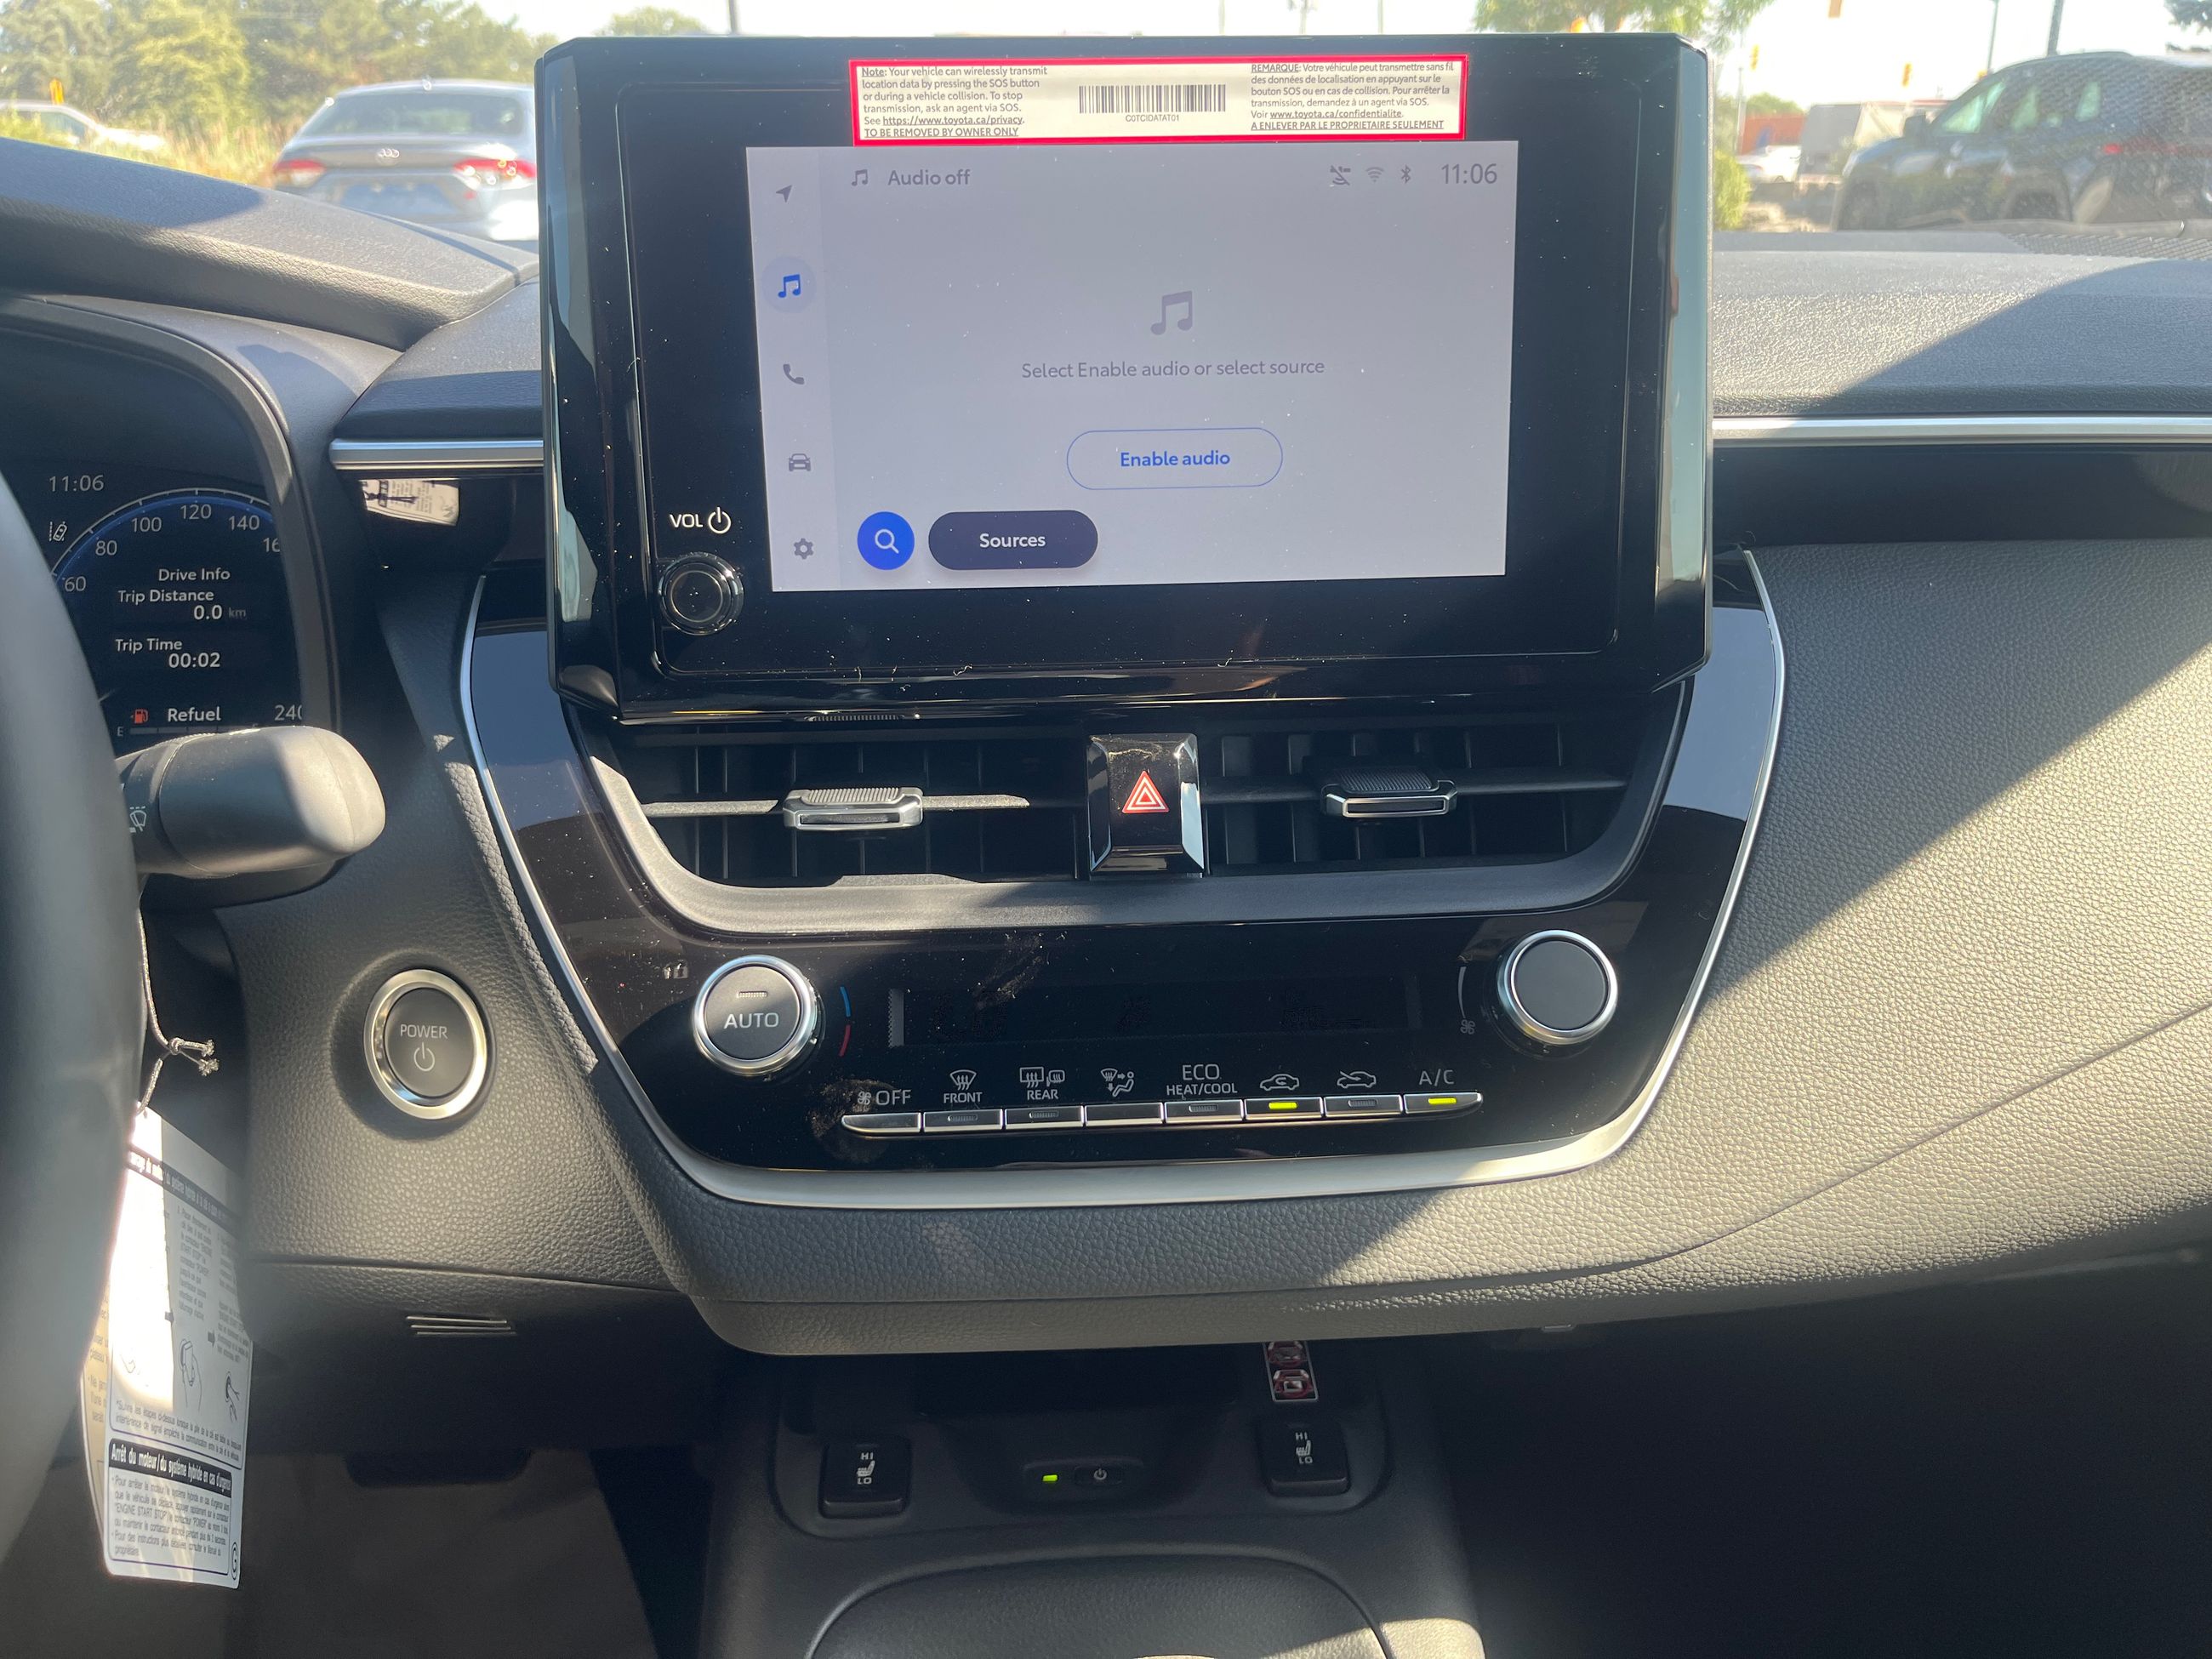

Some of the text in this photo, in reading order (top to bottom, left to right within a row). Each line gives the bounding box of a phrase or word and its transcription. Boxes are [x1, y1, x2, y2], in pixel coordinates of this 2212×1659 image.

[862, 68, 887, 77] Note:
[889, 67, 909, 76] Your
[912, 67, 944, 76] vehicle
[964, 66, 1007, 77] wirelessly
[1009, 66, 1047, 75] transmit
[1251, 65, 1301, 73] REMARQUE:
[1325, 63, 1357, 72] véhicule
[1360, 64, 1377, 73] peut
[1379, 63, 1425, 71] transmettre
[863, 79, 1039, 89] location data by pressing the SOS button
[1251, 76, 1266, 84] des
[1268, 75, 1303, 83] données
[1306, 75, 1315, 83] de
[1318, 75, 1364, 83] localisation
[1378, 76, 1417, 85] appuyant
[1433, 74, 1440, 83] le
[875, 92, 904, 102] during
[915, 92, 945, 100] vehicle
[948, 91, 988, 100] collision.
[990, 91, 1001, 100] To
[1003, 91, 1023, 102] stop
[1251, 87, 1281, 96] bouton
[1284, 87, 1301, 95] SOS
[1342, 86, 1352, 94] de
[1354, 86, 1390, 94] collision.
[1393, 86, 1411, 94] Pour
[1412, 85, 1440, 94] arrêter
[1442, 85, 1450, 94] la
[864, 105, 923, 114] transmission,
[926, 104, 940, 112] ask
[956, 105, 983, 114] agent
[984, 104, 997, 112] via
[1000, 104, 1021, 112] SOS.
[1251, 99, 1304, 108] transmission,
[1307, 98, 1349, 106] demandez
[1351, 97, 1356, 106] à
[1371, 98, 1394, 107] agent
[1397, 97, 1407, 105] via
[1410, 97, 1428, 105] SOS.
[864, 117, 881, 125] See
[1251, 111, 1268, 119] Voir
[1259, 121, 1297, 130] ENLEVER
[1300, 121, 1316, 129] PAR
[1319, 121, 1327, 129] LE
[1330, 121, 1390, 129] PROPRIETAIRE
[1393, 120, 1444, 129] SEULEMENT
[864, 128, 1018, 138] TO BE REMOVED BY OWNER ONLY
[887, 168, 971, 185] Audio off
[1441, 163, 1497, 185] 11:06
[1022, 360, 1325, 378] Select Enable audio or select source
[1120, 450, 1230, 466] Enable audio
[48, 474, 105, 493] 11:06
[180, 504, 212, 520] 120
[131, 516, 162, 533] 100
[229, 515, 260, 531] 140
[669, 514, 704, 527] VOL
[95, 539, 117, 556] 80
[263, 537, 281, 553] 16
[979, 533, 1046, 548] Sources
[158, 567, 231, 582] Drive Info
[64, 576, 87, 592] 60
[117, 589, 214, 605] Trip Distance
[193, 604, 247, 620] 0.0 km
[115, 638, 182, 653] Trip Time
[168, 652, 221, 668] 00:02
[168, 706, 221, 721] Refuel
[117, 727, 123, 738] E
[723, 1012, 780, 1029] AUTO
[400, 1023, 448, 1040] POWER
[1182, 1063, 1220, 1080] ECO
[1418, 1068, 1455, 1087] A/C
[1027, 1089, 1059, 1101] REAR
[1166, 1082, 1238, 1096] HEAT/COOL
[875, 1089, 912, 1105] OFF
[944, 1092, 983, 1103] FRONT
[1295, 1432, 1308, 1440] HI
[860, 1451, 874, 1460] HI
